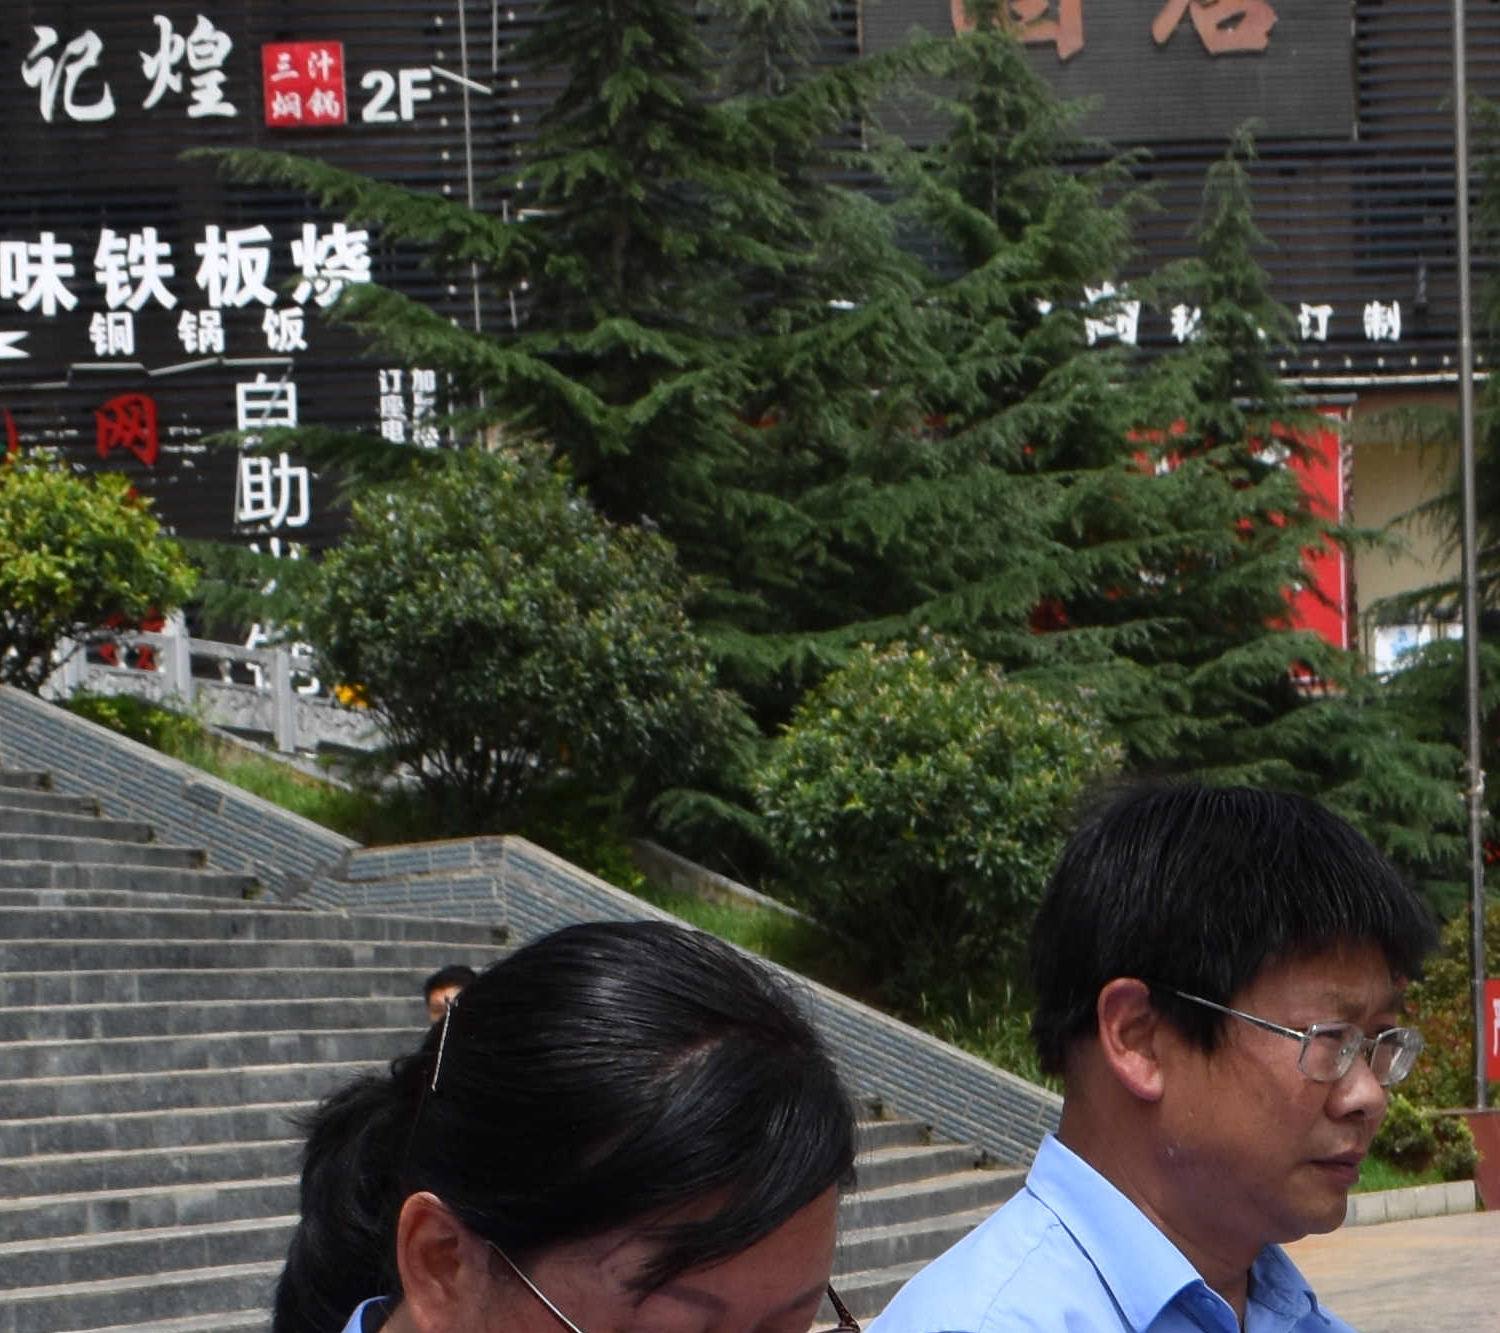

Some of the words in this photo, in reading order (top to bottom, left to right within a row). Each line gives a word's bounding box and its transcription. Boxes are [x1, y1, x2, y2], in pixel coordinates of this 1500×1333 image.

[270, 49, 334, 82] 三汁
[360, 68, 433, 123] 2F
[89, 307, 308, 357] 铜锅饭
